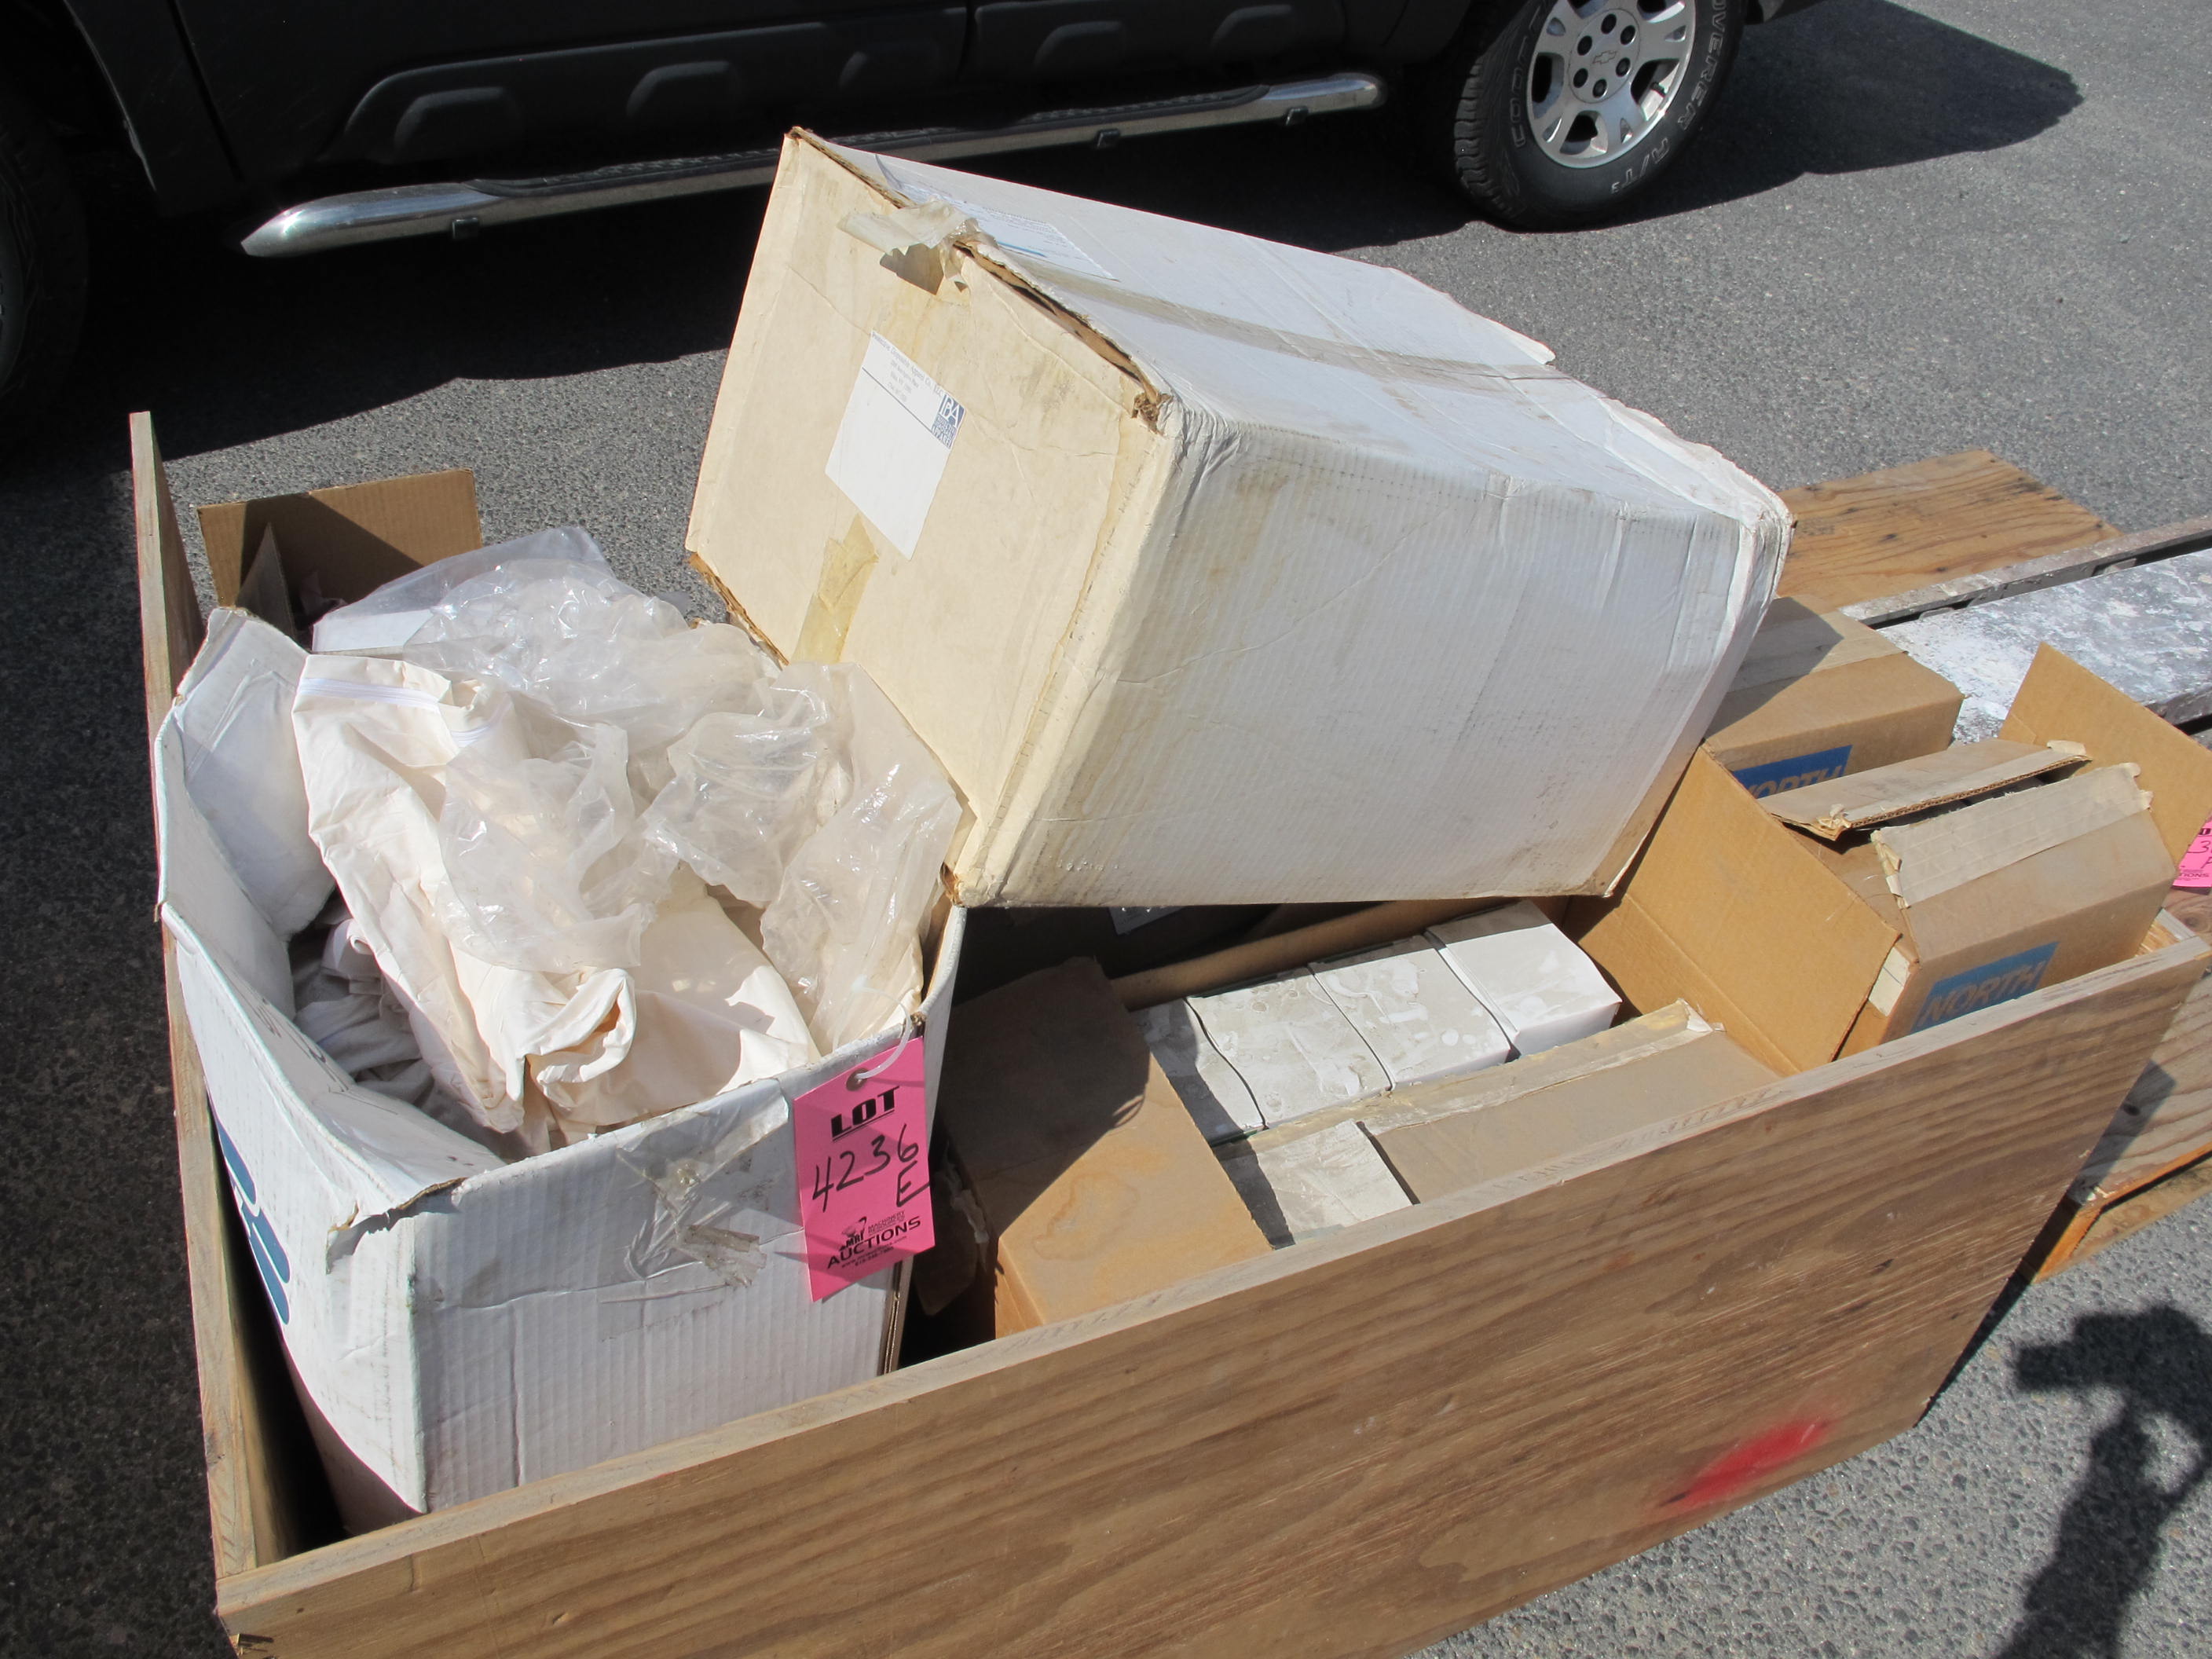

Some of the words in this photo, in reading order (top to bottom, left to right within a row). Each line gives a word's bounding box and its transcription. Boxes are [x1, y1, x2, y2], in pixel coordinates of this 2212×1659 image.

[1917, 960, 2046, 1027] NORTH
[830, 1086, 899, 1139] LOT
[812, 1123, 919, 1212] 4236
[895, 1159, 932, 1208] E
[828, 1216, 921, 1269] AUCTIONS
